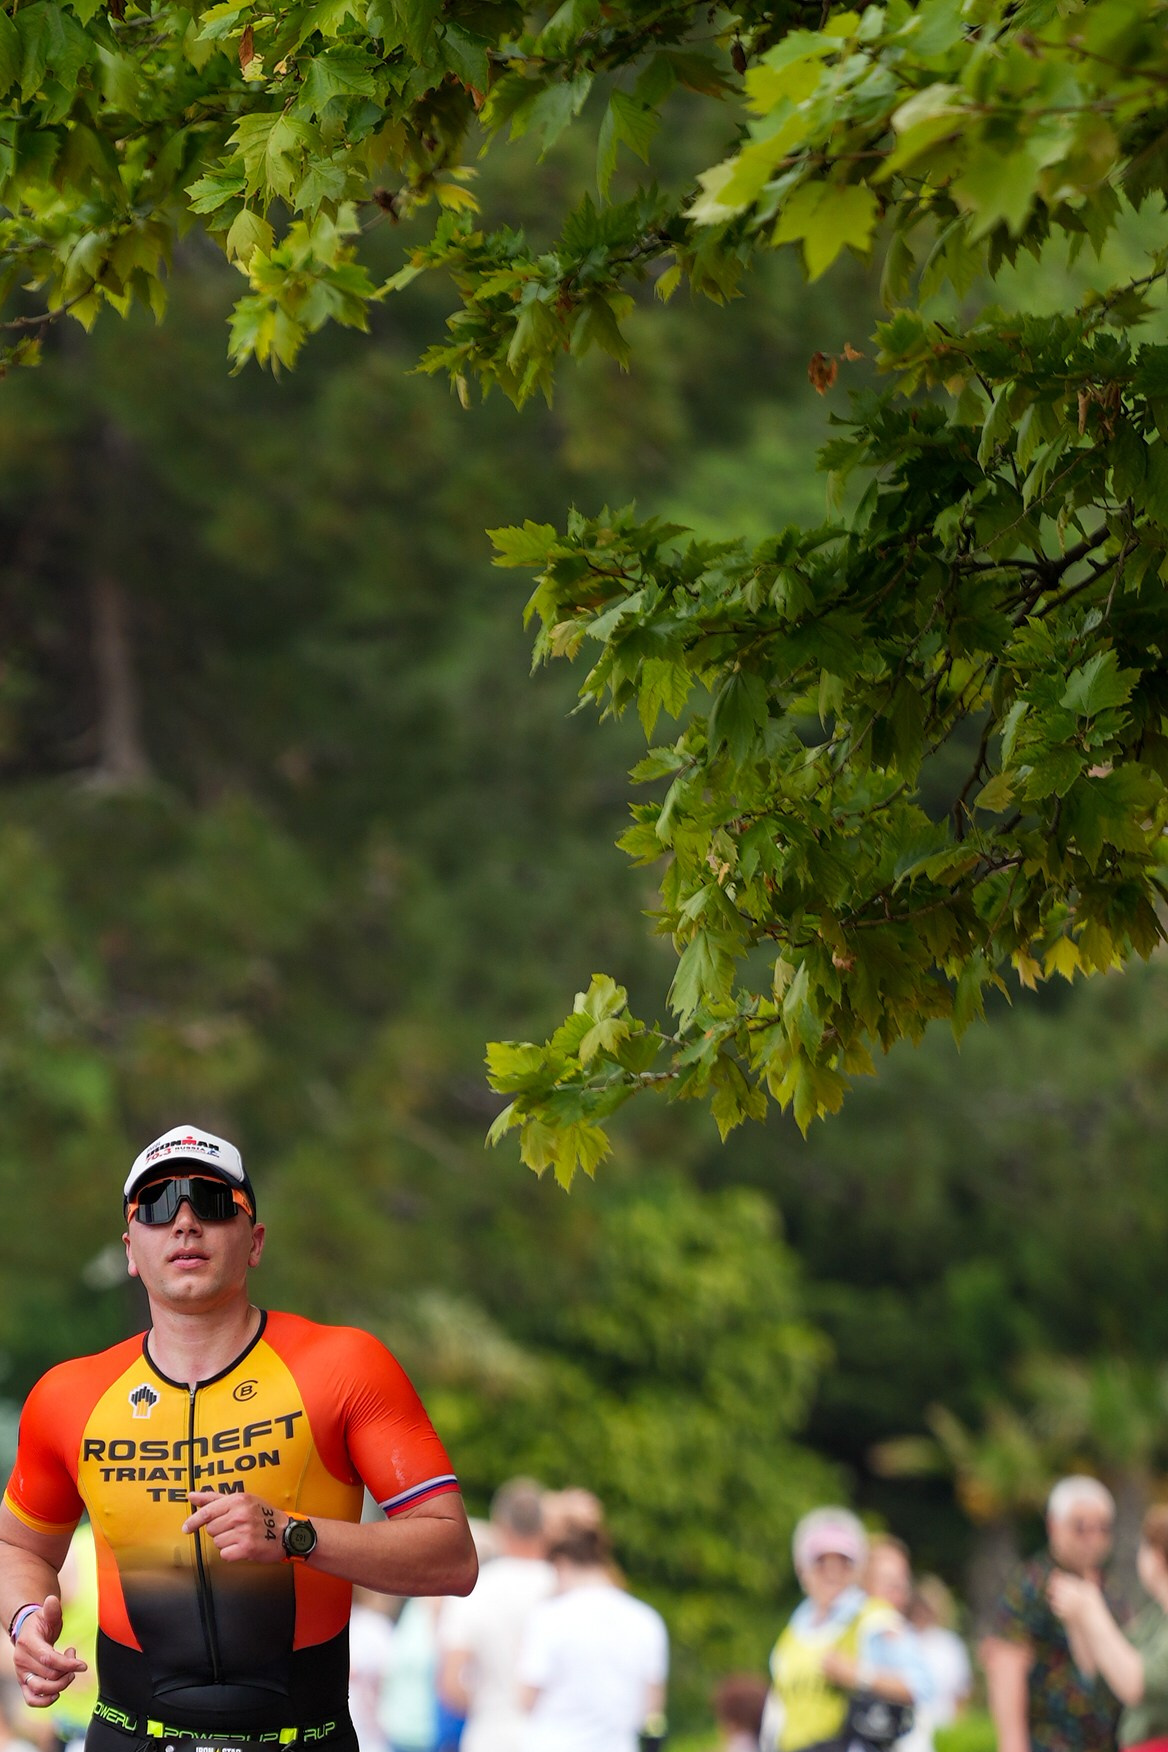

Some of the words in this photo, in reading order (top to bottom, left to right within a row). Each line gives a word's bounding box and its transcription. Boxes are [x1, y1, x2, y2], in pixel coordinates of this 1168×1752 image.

[145, 1136, 220, 1159] IRONMAN
[83, 1410, 303, 1462] ROSNEFT
[99, 1449, 281, 1482] TRIATHLON
[146, 1480, 245, 1503] TEAM
[261, 1506, 277, 1541] 394
